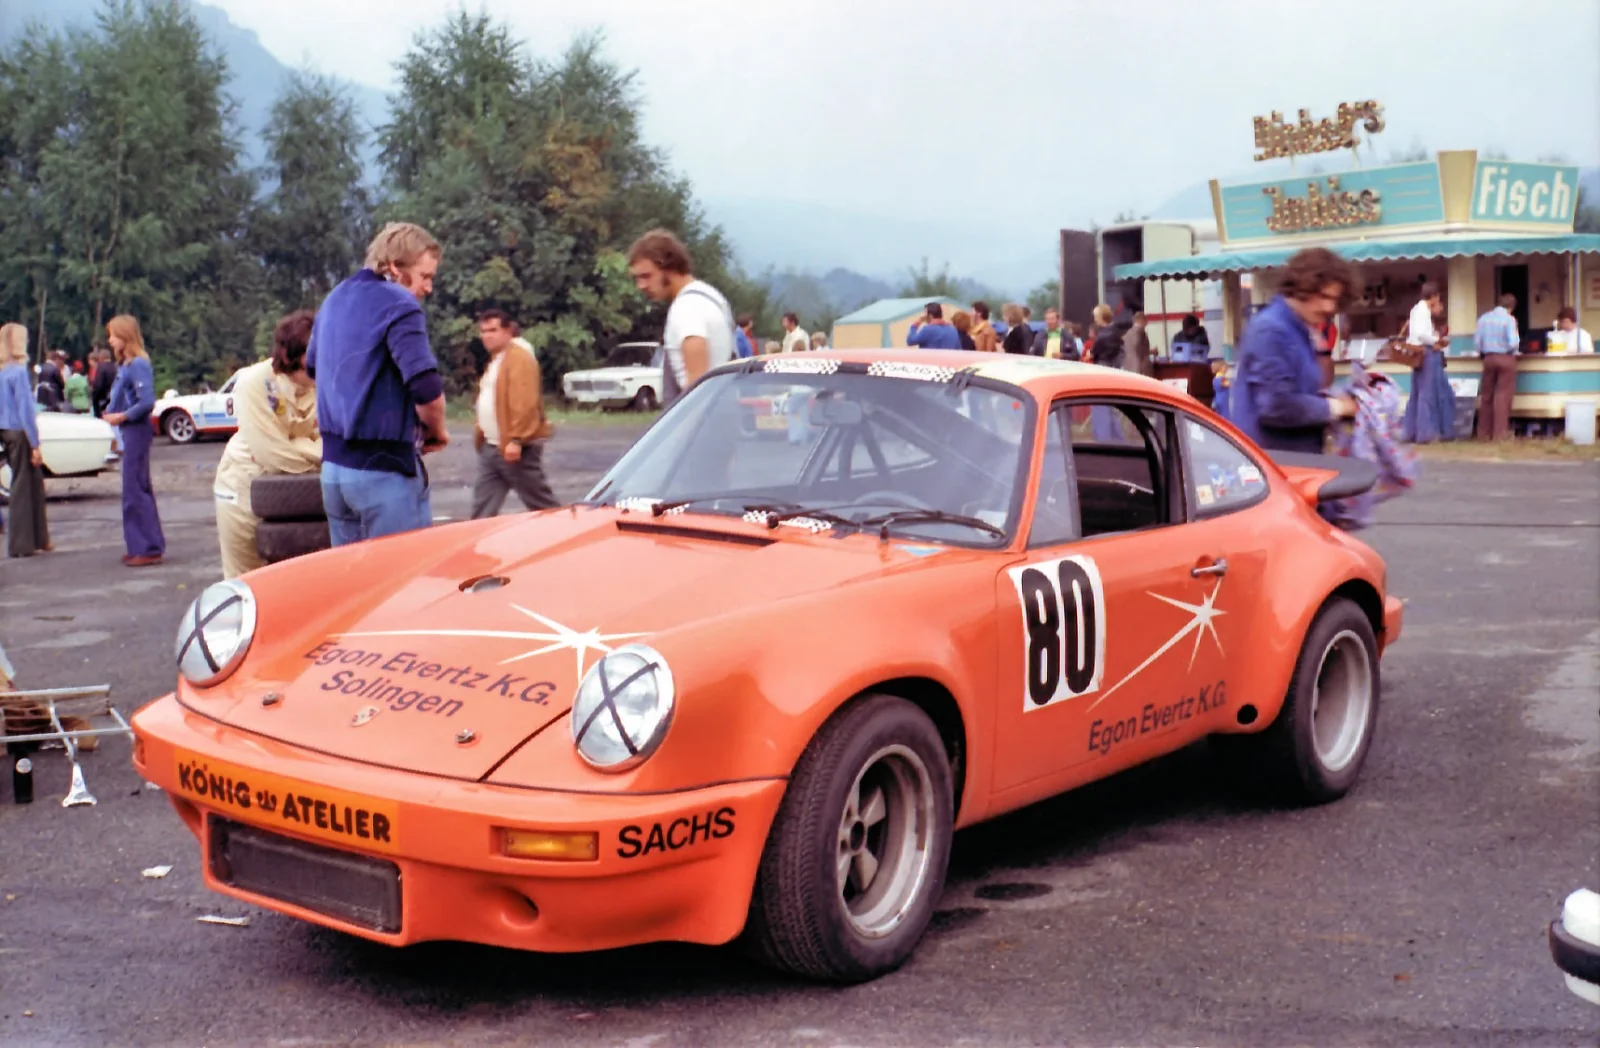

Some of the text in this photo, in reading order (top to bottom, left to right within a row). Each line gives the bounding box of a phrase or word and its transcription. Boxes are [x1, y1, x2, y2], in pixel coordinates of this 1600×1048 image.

[1477, 166, 1570, 218] Fisch
[1021, 560, 1096, 706] 80
[303, 641, 557, 706] Egon Evertz K.G.
[321, 670, 464, 716] Solingen
[1088, 715, 1136, 755] Egon
[1140, 695, 1196, 735] Evertz
[178, 760, 391, 844] KÖNIG ATELIER
[617, 806, 736, 859] SACHS
